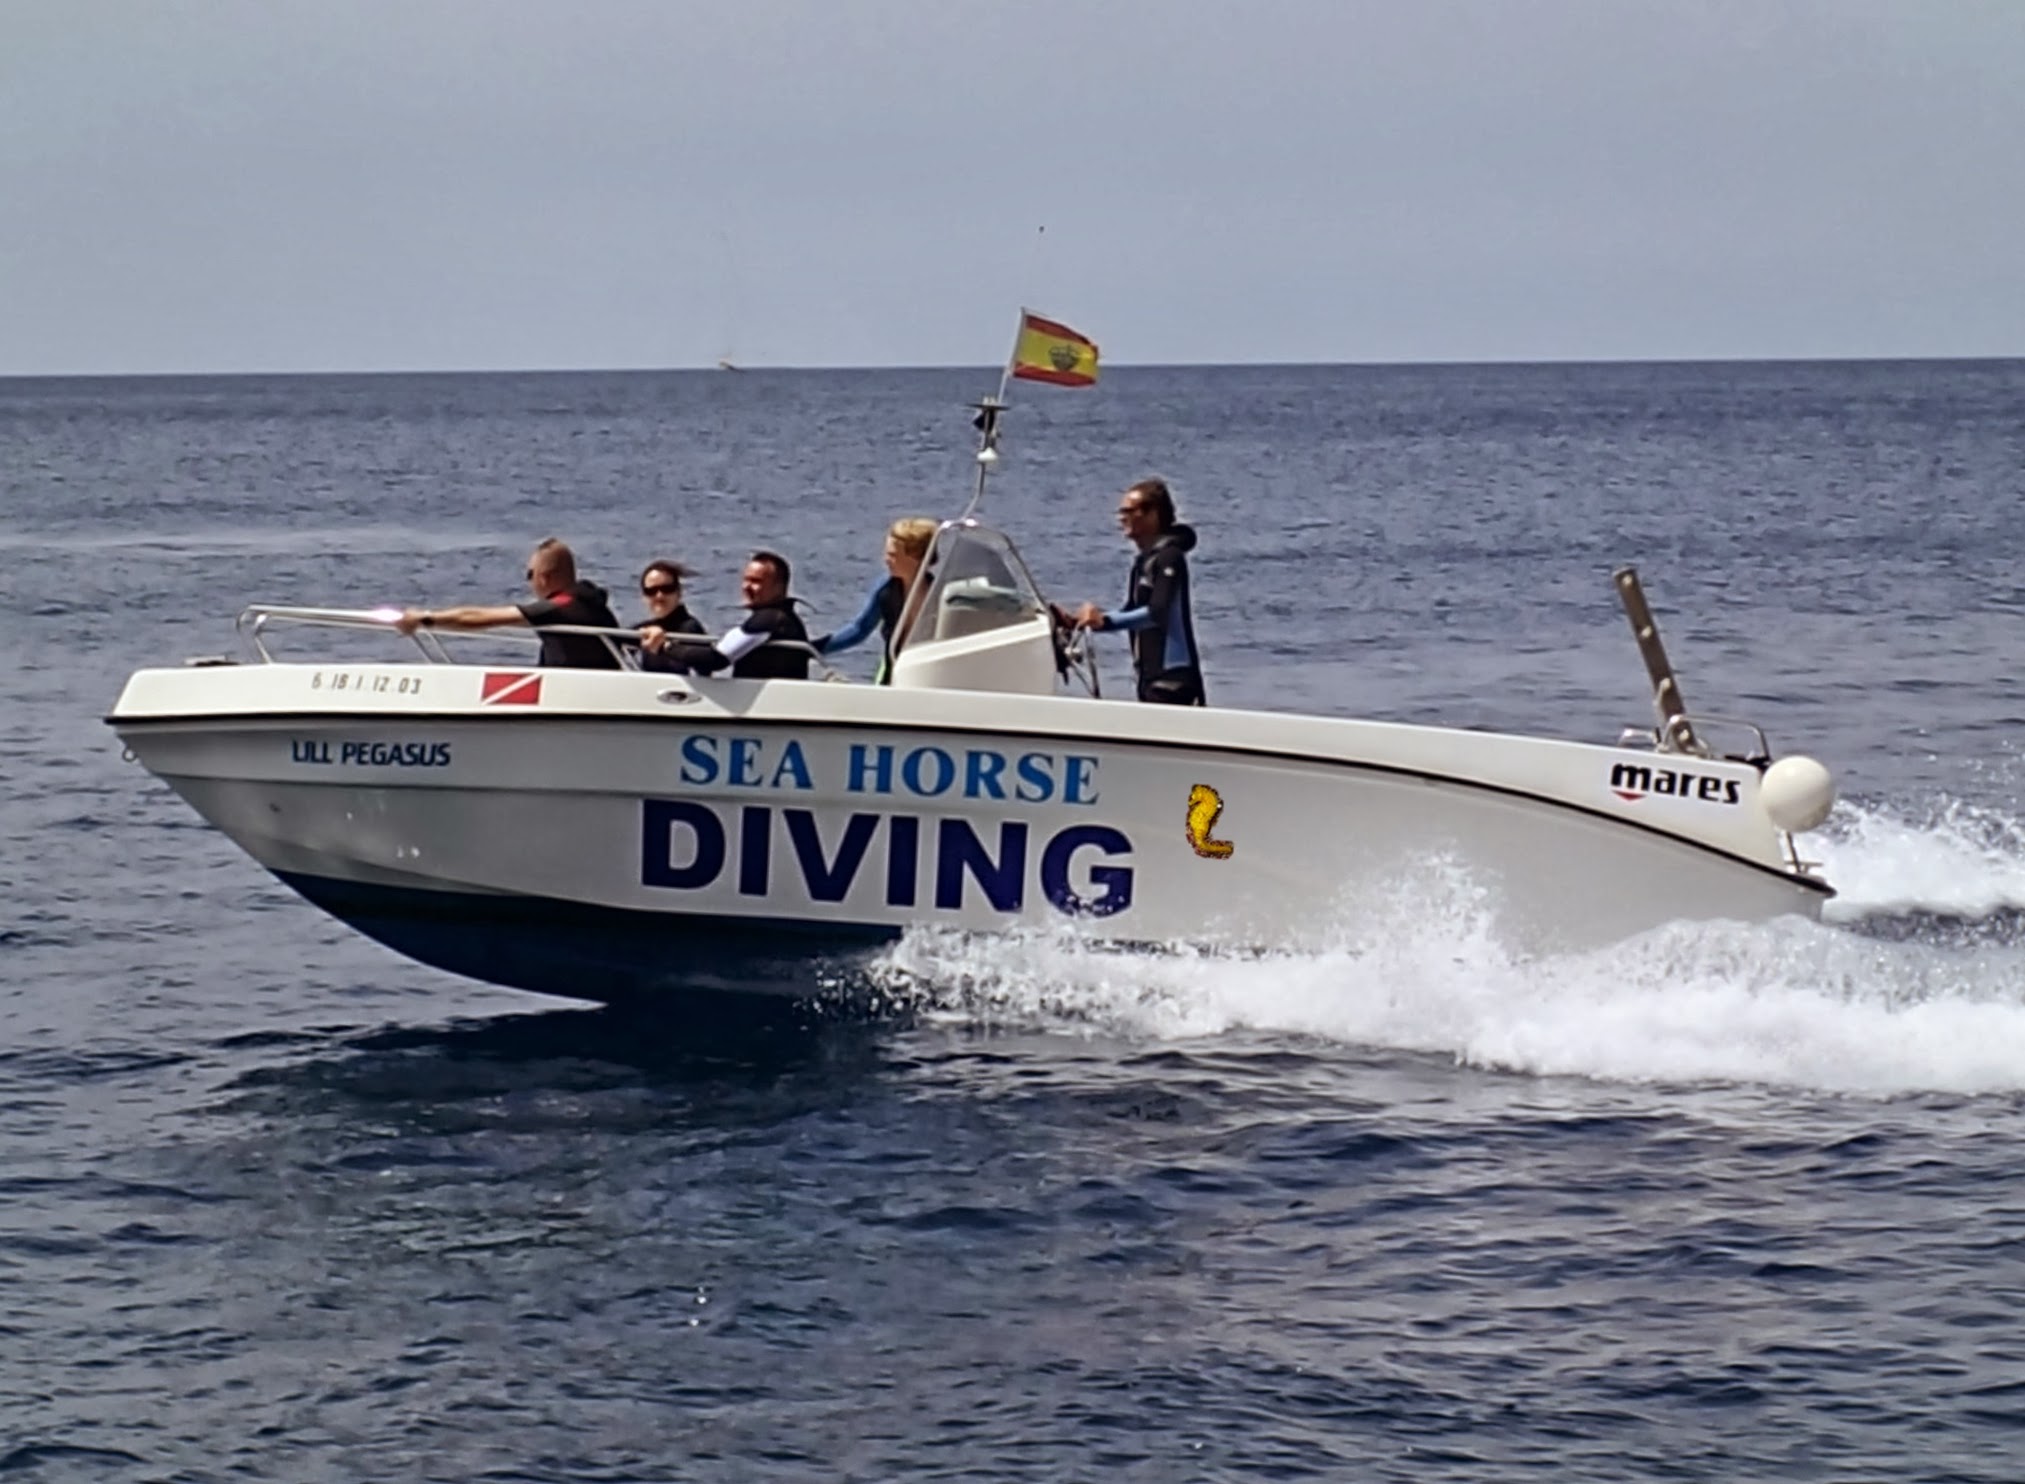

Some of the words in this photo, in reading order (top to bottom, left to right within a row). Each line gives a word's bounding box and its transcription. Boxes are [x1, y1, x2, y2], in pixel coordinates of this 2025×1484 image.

[341, 742, 452, 767] PEGASUS
[680, 735, 813, 790] SEA
[847, 744, 1099, 805] HORSE
[1611, 763, 1741, 805] mares
[642, 799, 1134, 919] DIVING
